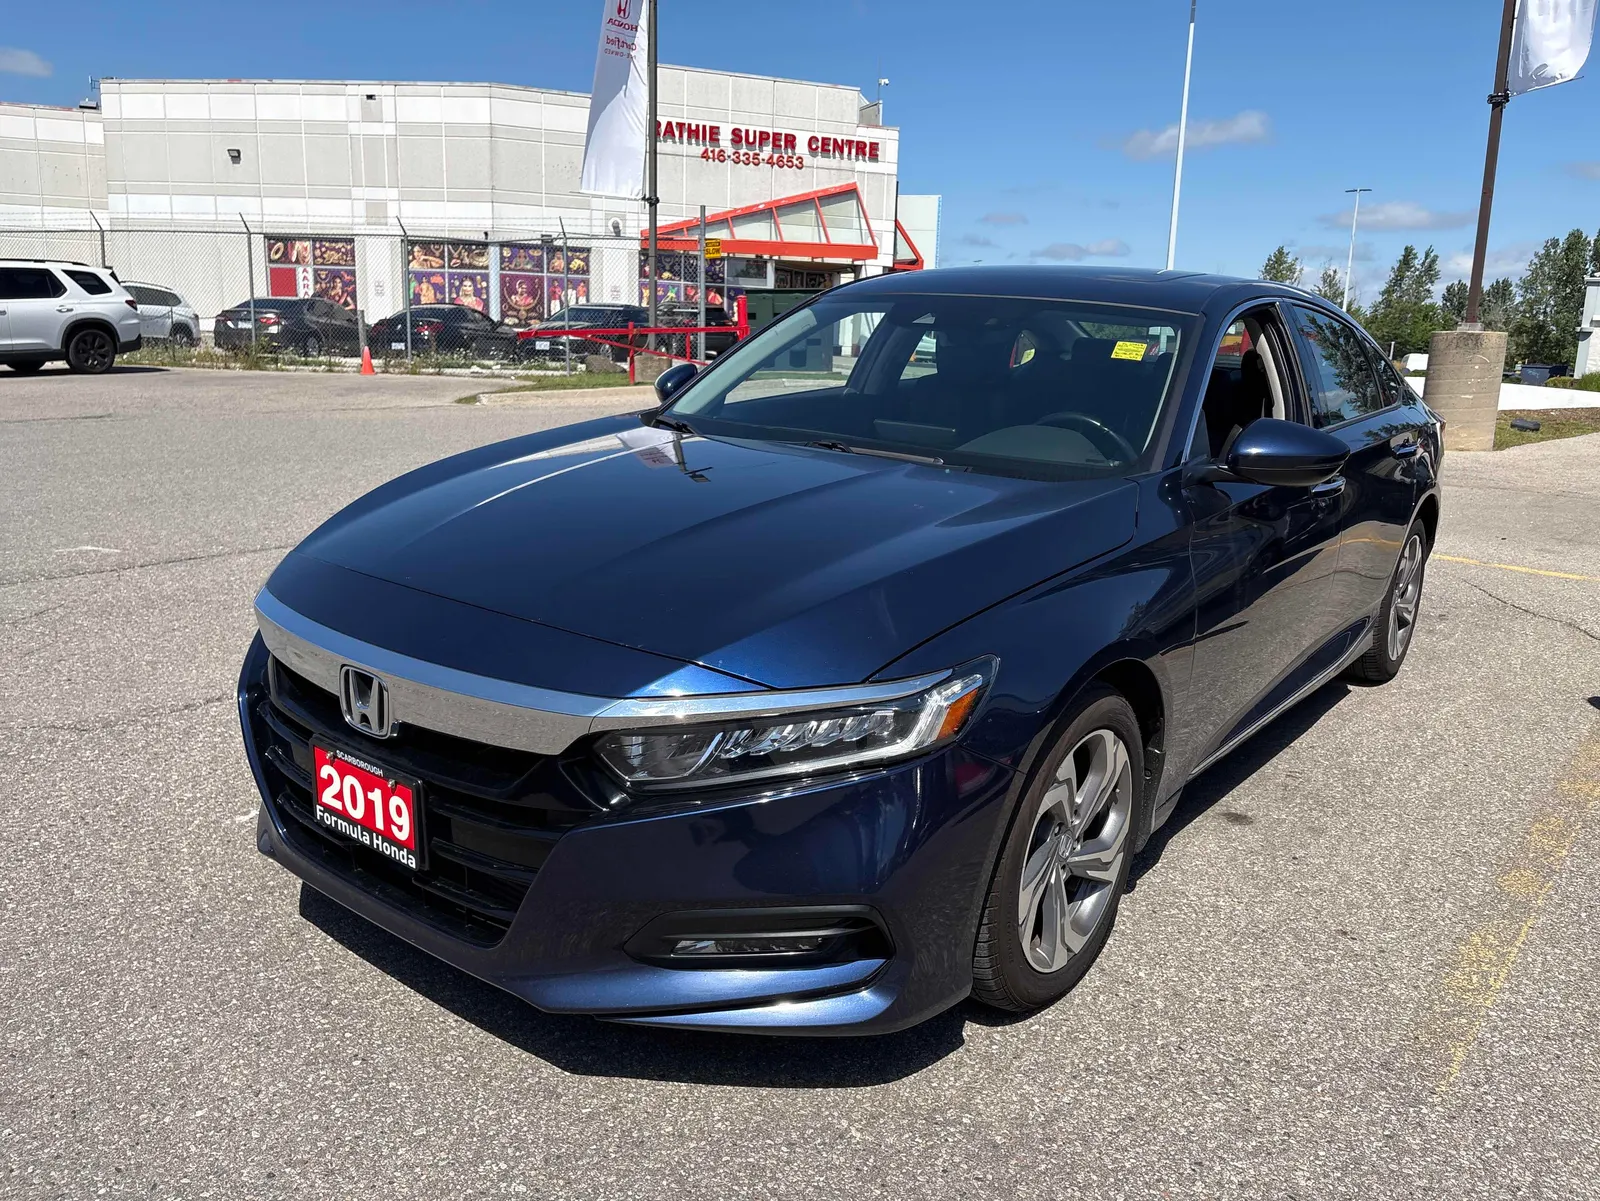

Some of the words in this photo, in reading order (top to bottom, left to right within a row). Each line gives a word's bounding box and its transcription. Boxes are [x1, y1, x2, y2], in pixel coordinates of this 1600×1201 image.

[700, 147, 805, 170] 416-335-4653
[731, 127, 797, 151] SUPER
[807, 135, 880, 159] CENTRE
[336, 750, 383, 777] SCARBOROUGH
[320, 764, 410, 841] 2019
[316, 805, 371, 846] Formula
[372, 832, 416, 869] Honda
